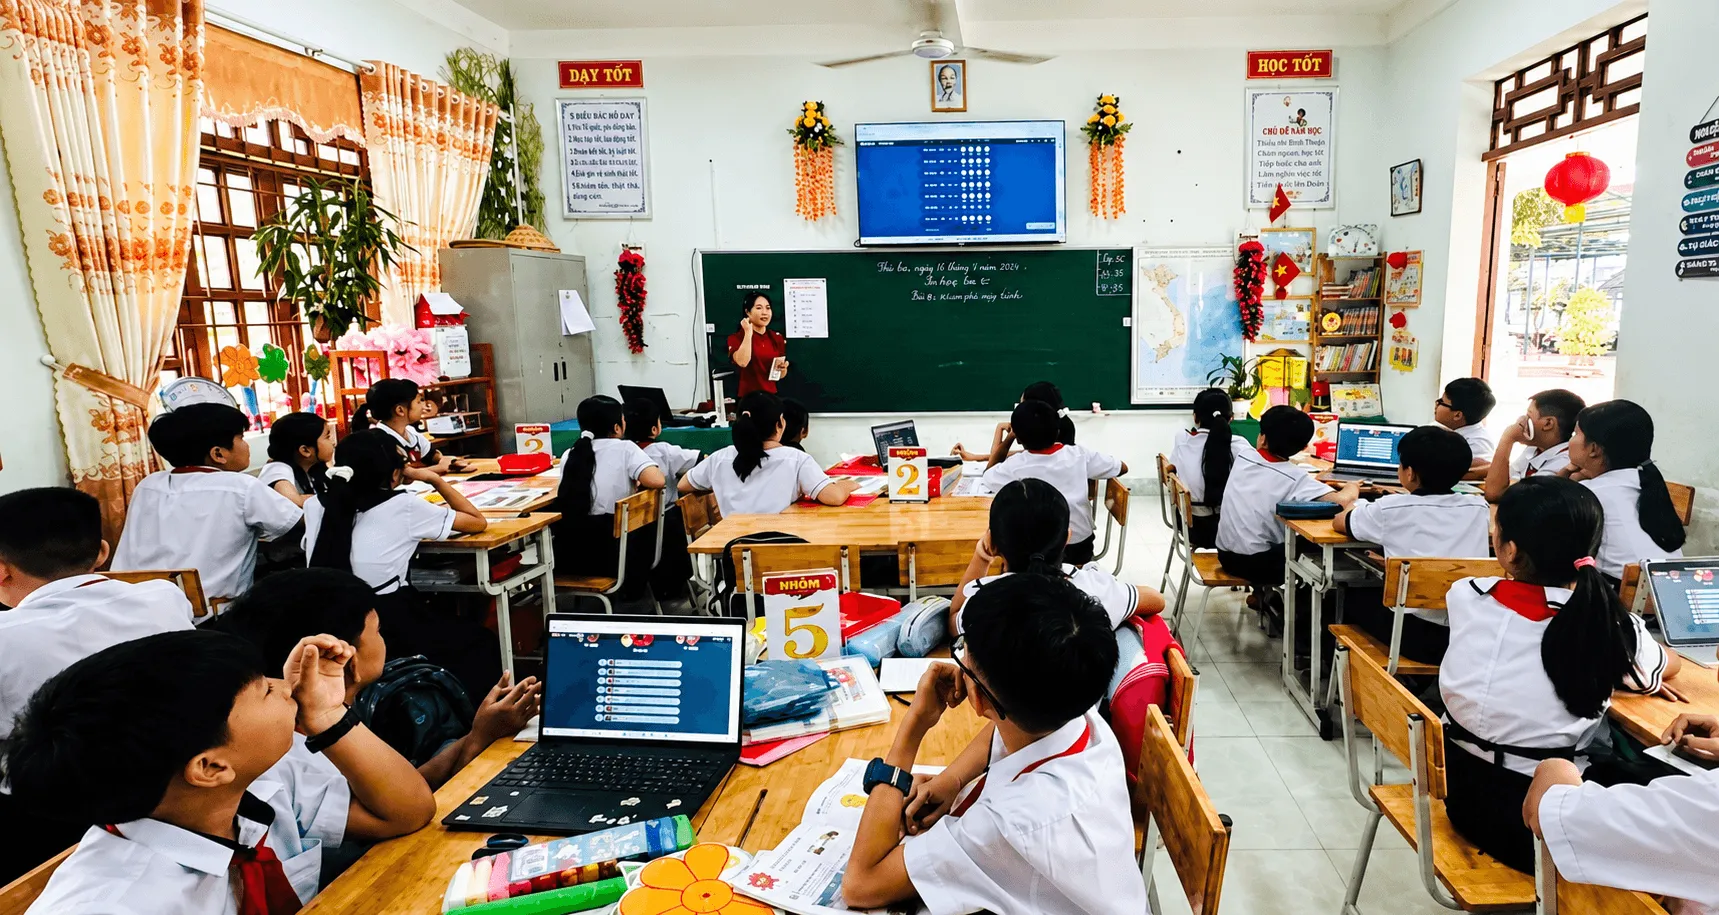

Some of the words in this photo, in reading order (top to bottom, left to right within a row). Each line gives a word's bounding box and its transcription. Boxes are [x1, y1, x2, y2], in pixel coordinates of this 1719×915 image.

[569, 68, 599, 84] DẠY
[603, 64, 632, 82] TỐT
[1258, 58, 1288, 76] HỌC
[1292, 52, 1322, 72] TỐT
[1000, 262, 1020, 271] 2024
[896, 464, 920, 495] 2
[780, 577, 820, 591] NHÓM
[784, 603, 828, 659] 5
